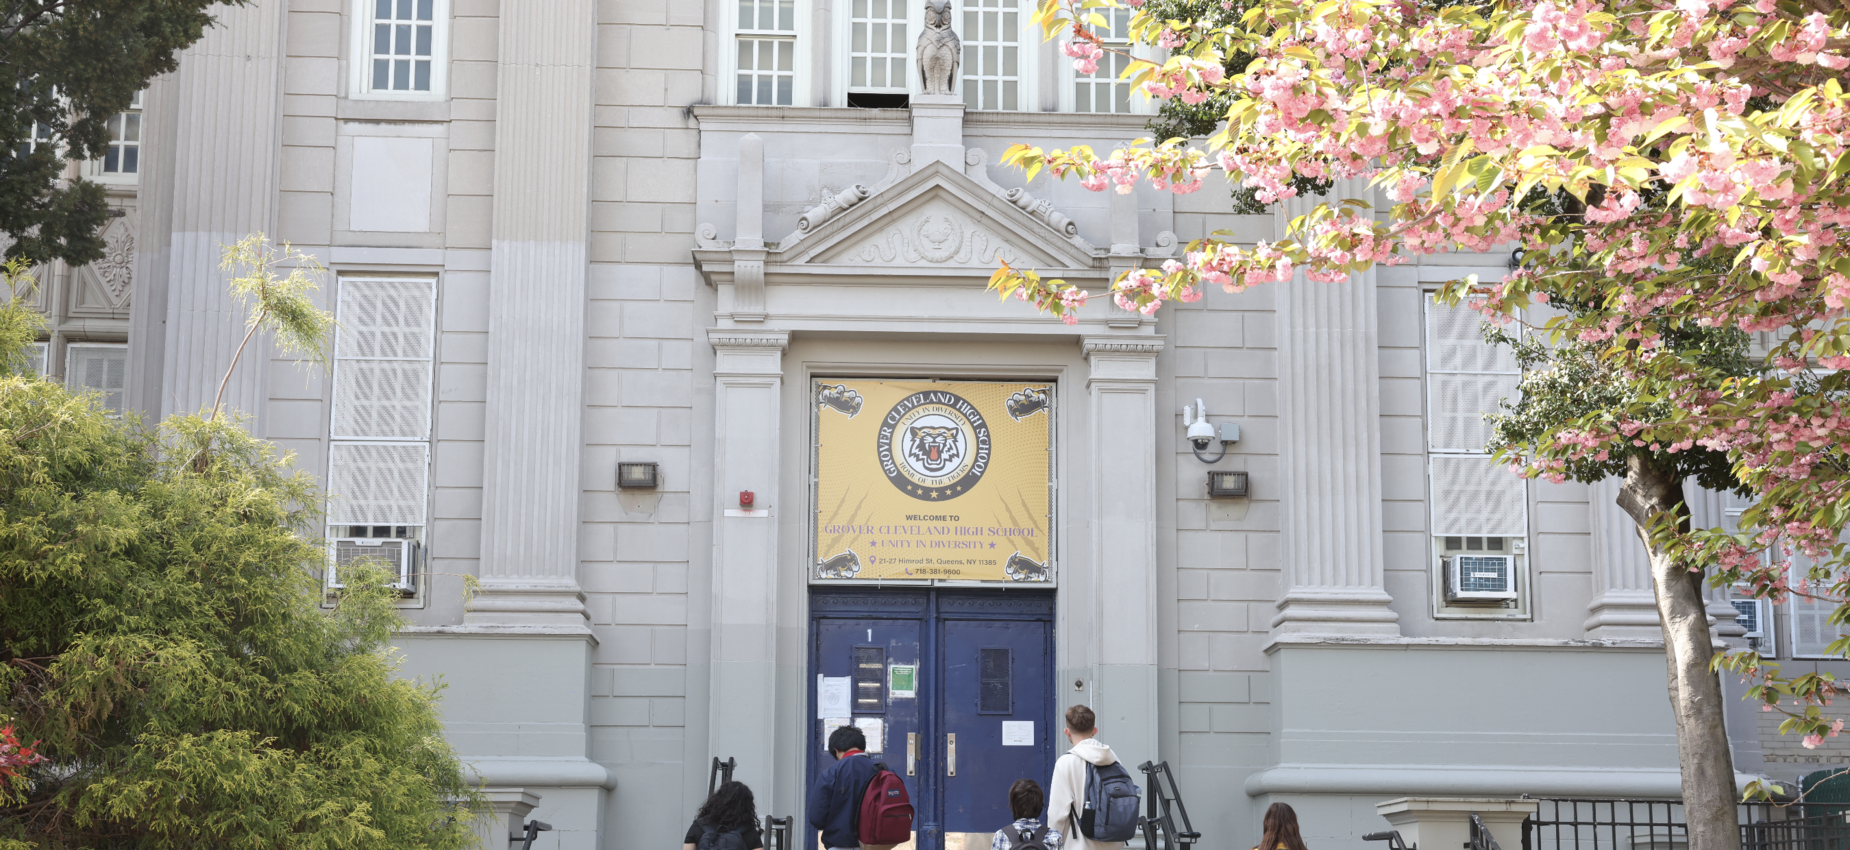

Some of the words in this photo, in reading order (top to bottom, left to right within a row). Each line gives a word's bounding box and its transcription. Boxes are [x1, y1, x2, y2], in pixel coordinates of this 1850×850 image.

[887, 392, 955, 425] CLEVELAND
[901, 409, 923, 426] UNITY
[922, 406, 931, 414] IN
[932, 406, 968, 427] DIVERSITY
[956, 399, 983, 427] HIGH
[879, 426, 898, 477] GROVER
[969, 428, 990, 477] SCHOOL
[898, 461, 916, 480] HOME
[946, 463, 969, 483] TIGERS
[905, 514, 947, 522] WELCOME
[824, 524, 875, 535] GROVER
[879, 525, 951, 536] CLEVELAND
[955, 526, 984, 537] HIGH
[987, 526, 1038, 538] SCHOOL
[881, 539, 912, 548] UNITY
[916, 540, 927, 549] IN
[930, 540, 985, 550] DIVERSITY
[936, 558, 965, 566] Queens,
[915, 568, 961, 576] 718-381-9600
[866, 628, 872, 643] 1
